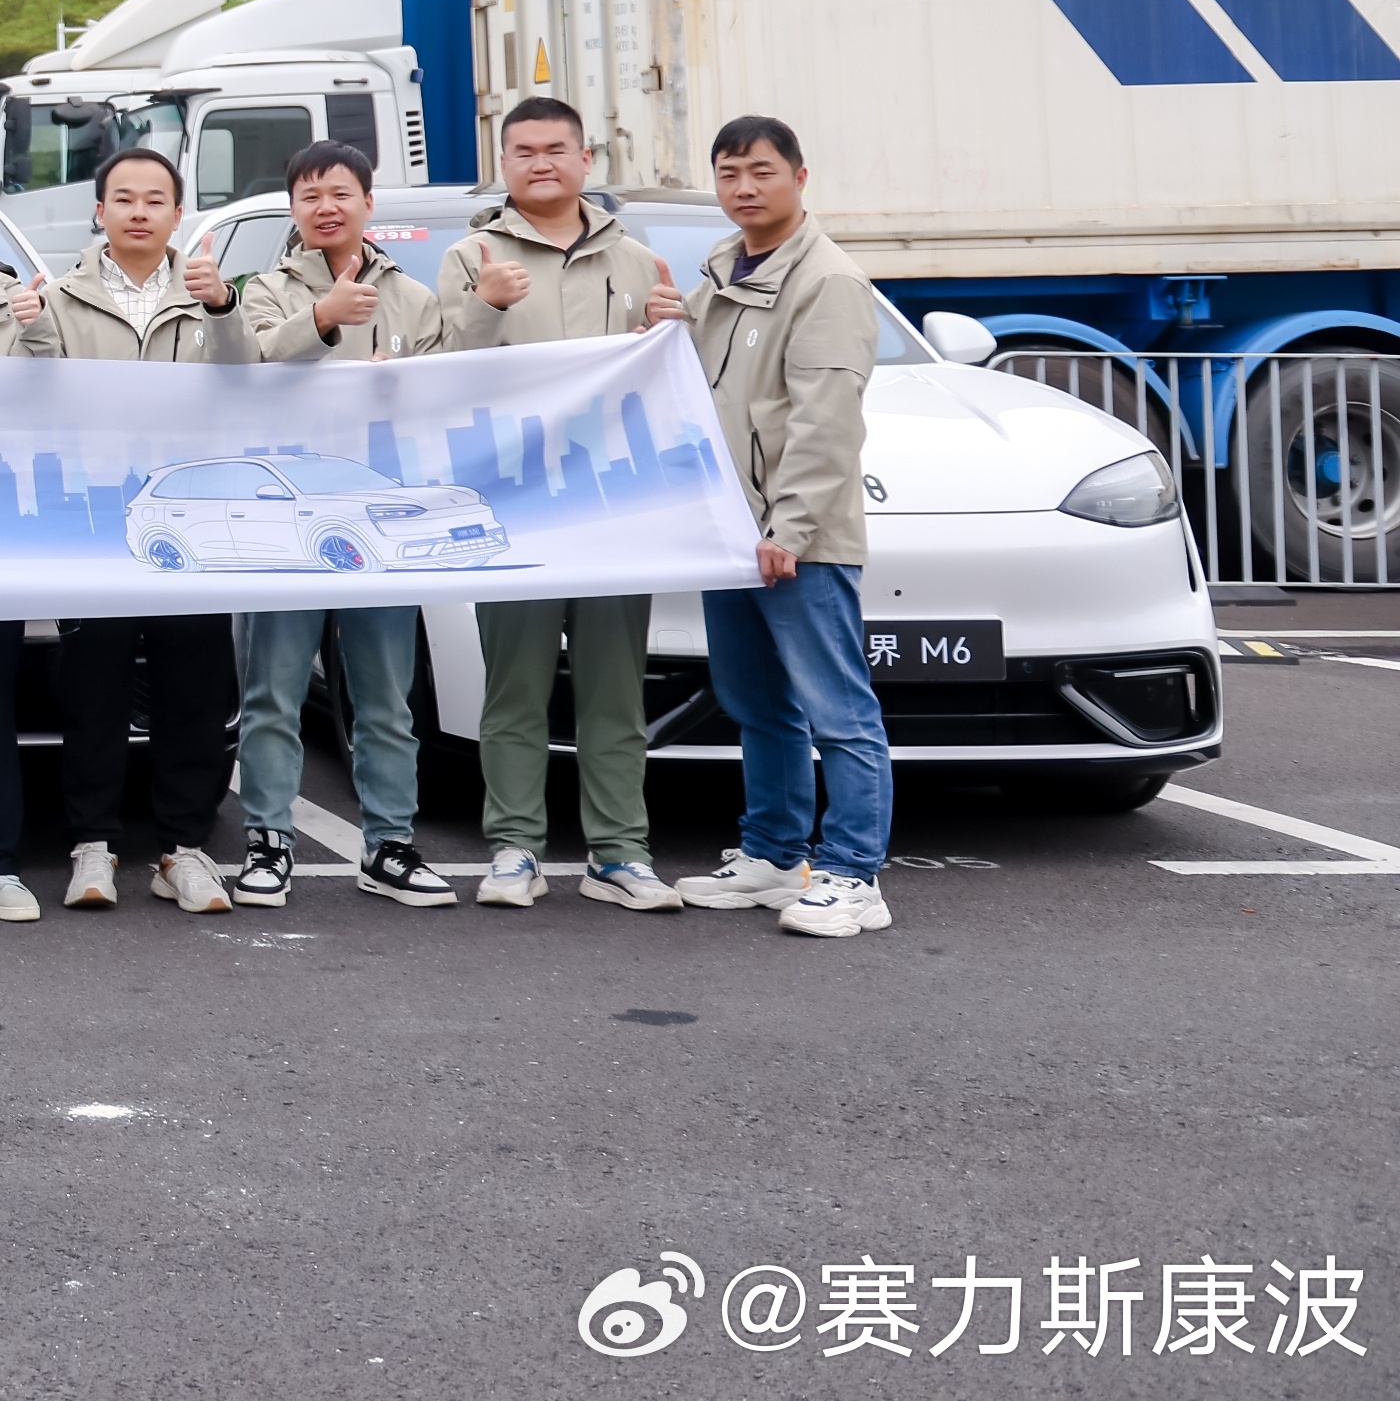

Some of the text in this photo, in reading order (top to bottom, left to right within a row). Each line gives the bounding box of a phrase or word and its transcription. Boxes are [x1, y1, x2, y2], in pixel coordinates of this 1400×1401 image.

[374, 231, 412, 240] 698
[920, 636, 972, 664] M6
[881, 856, 1001, 869] 05
